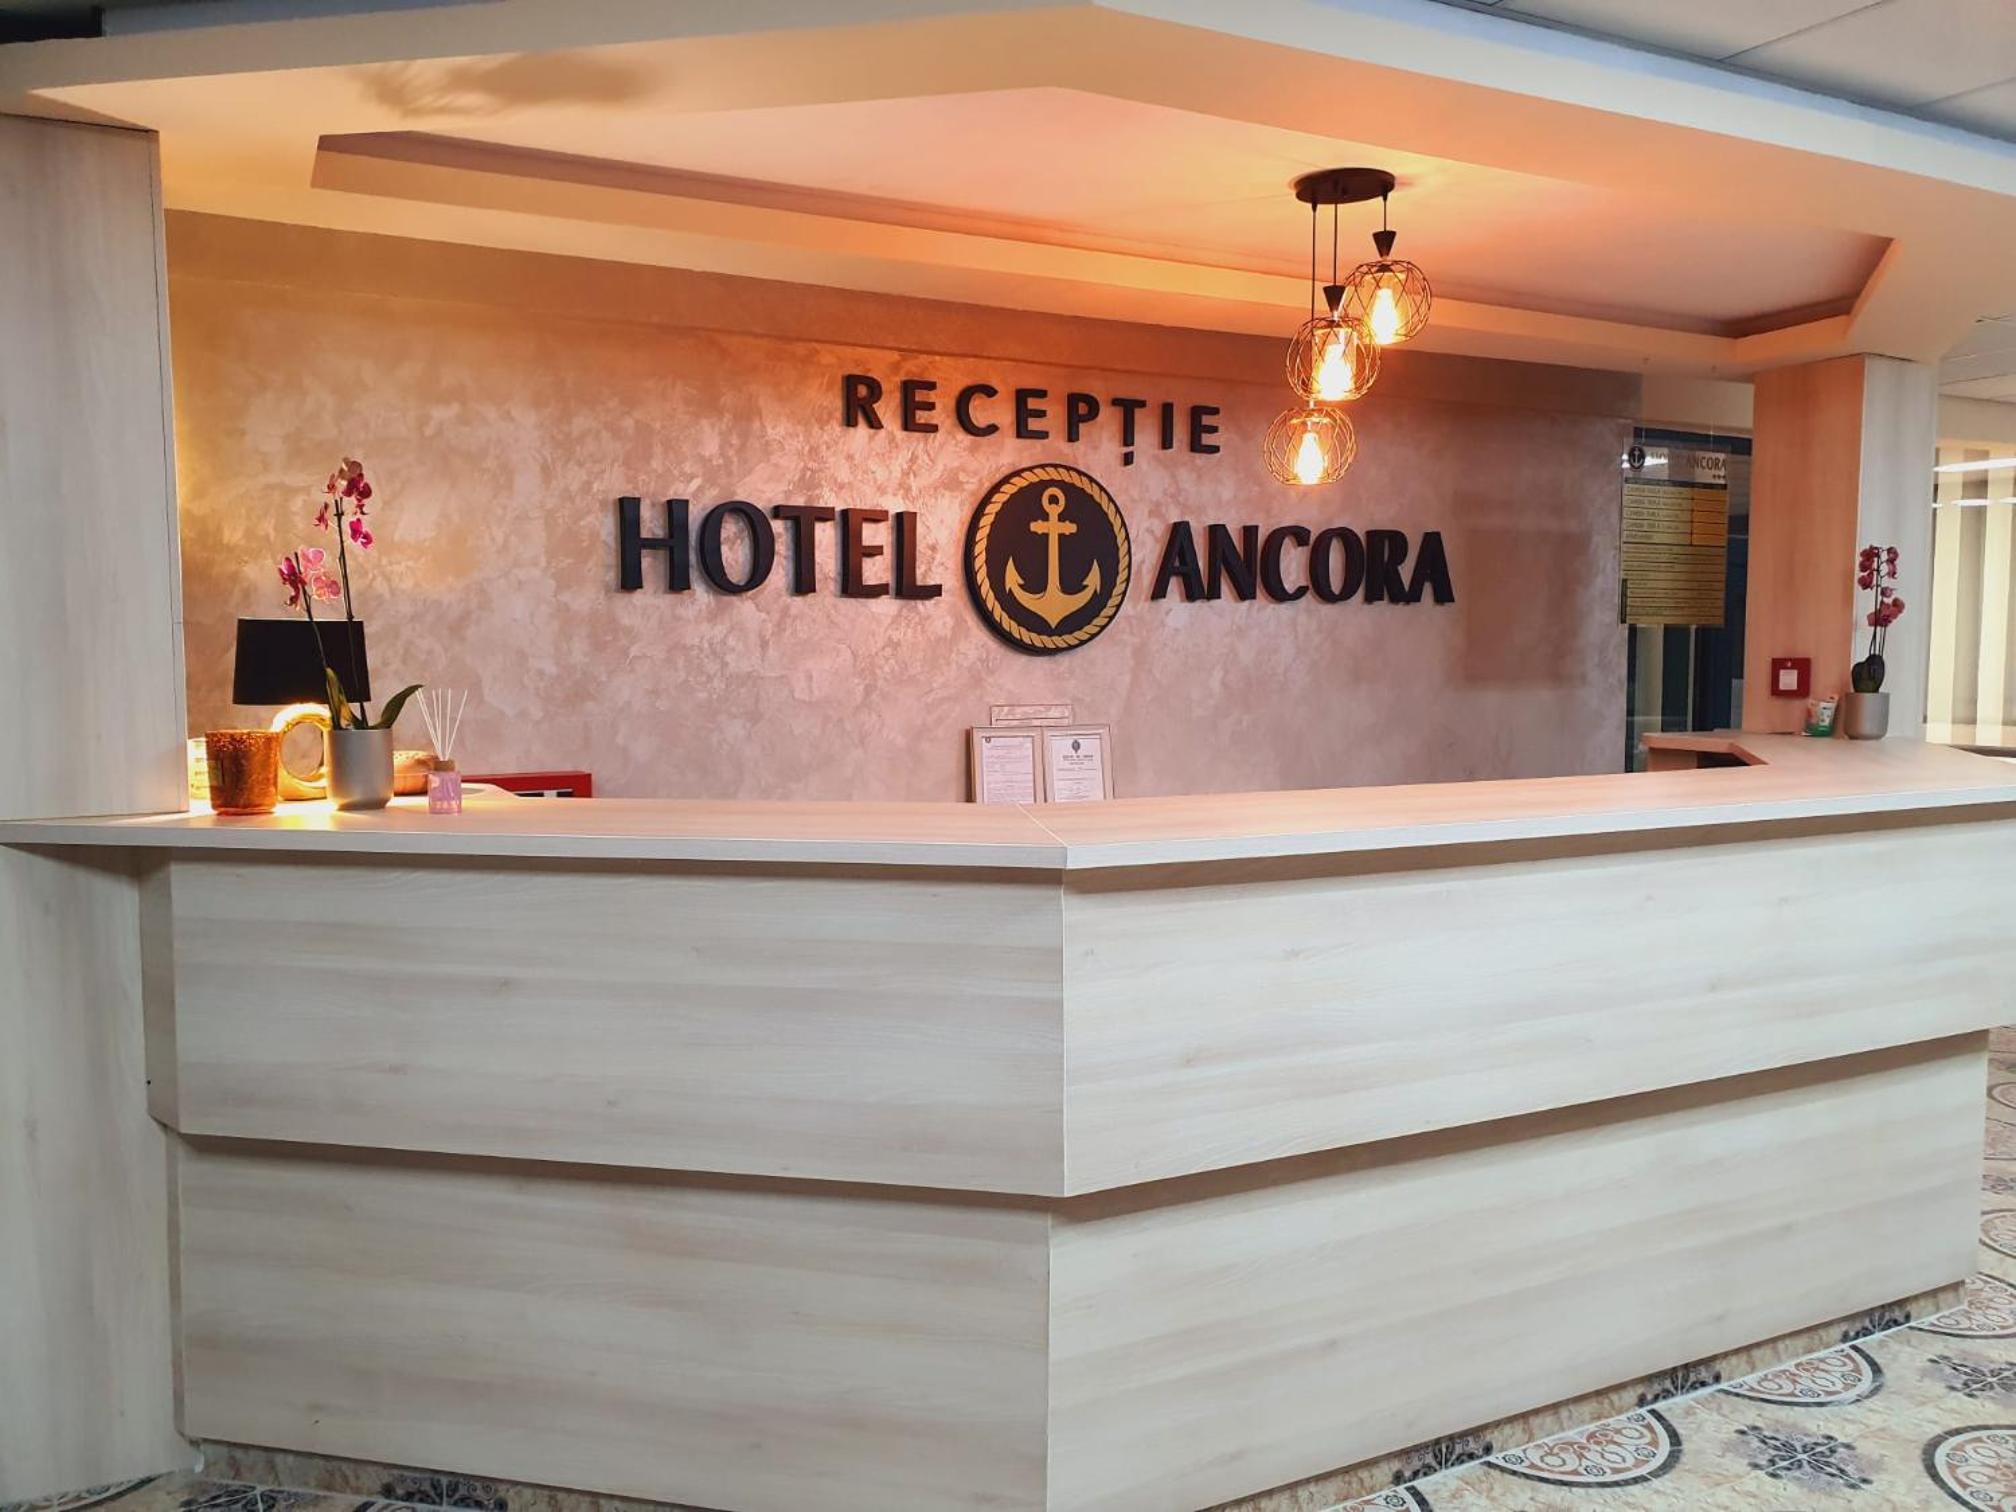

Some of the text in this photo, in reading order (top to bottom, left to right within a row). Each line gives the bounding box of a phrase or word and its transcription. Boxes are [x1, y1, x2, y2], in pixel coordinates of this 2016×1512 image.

[844, 373, 1221, 466] RECEPȚIE
[618, 496, 1456, 604] HOTEL ANCORA
